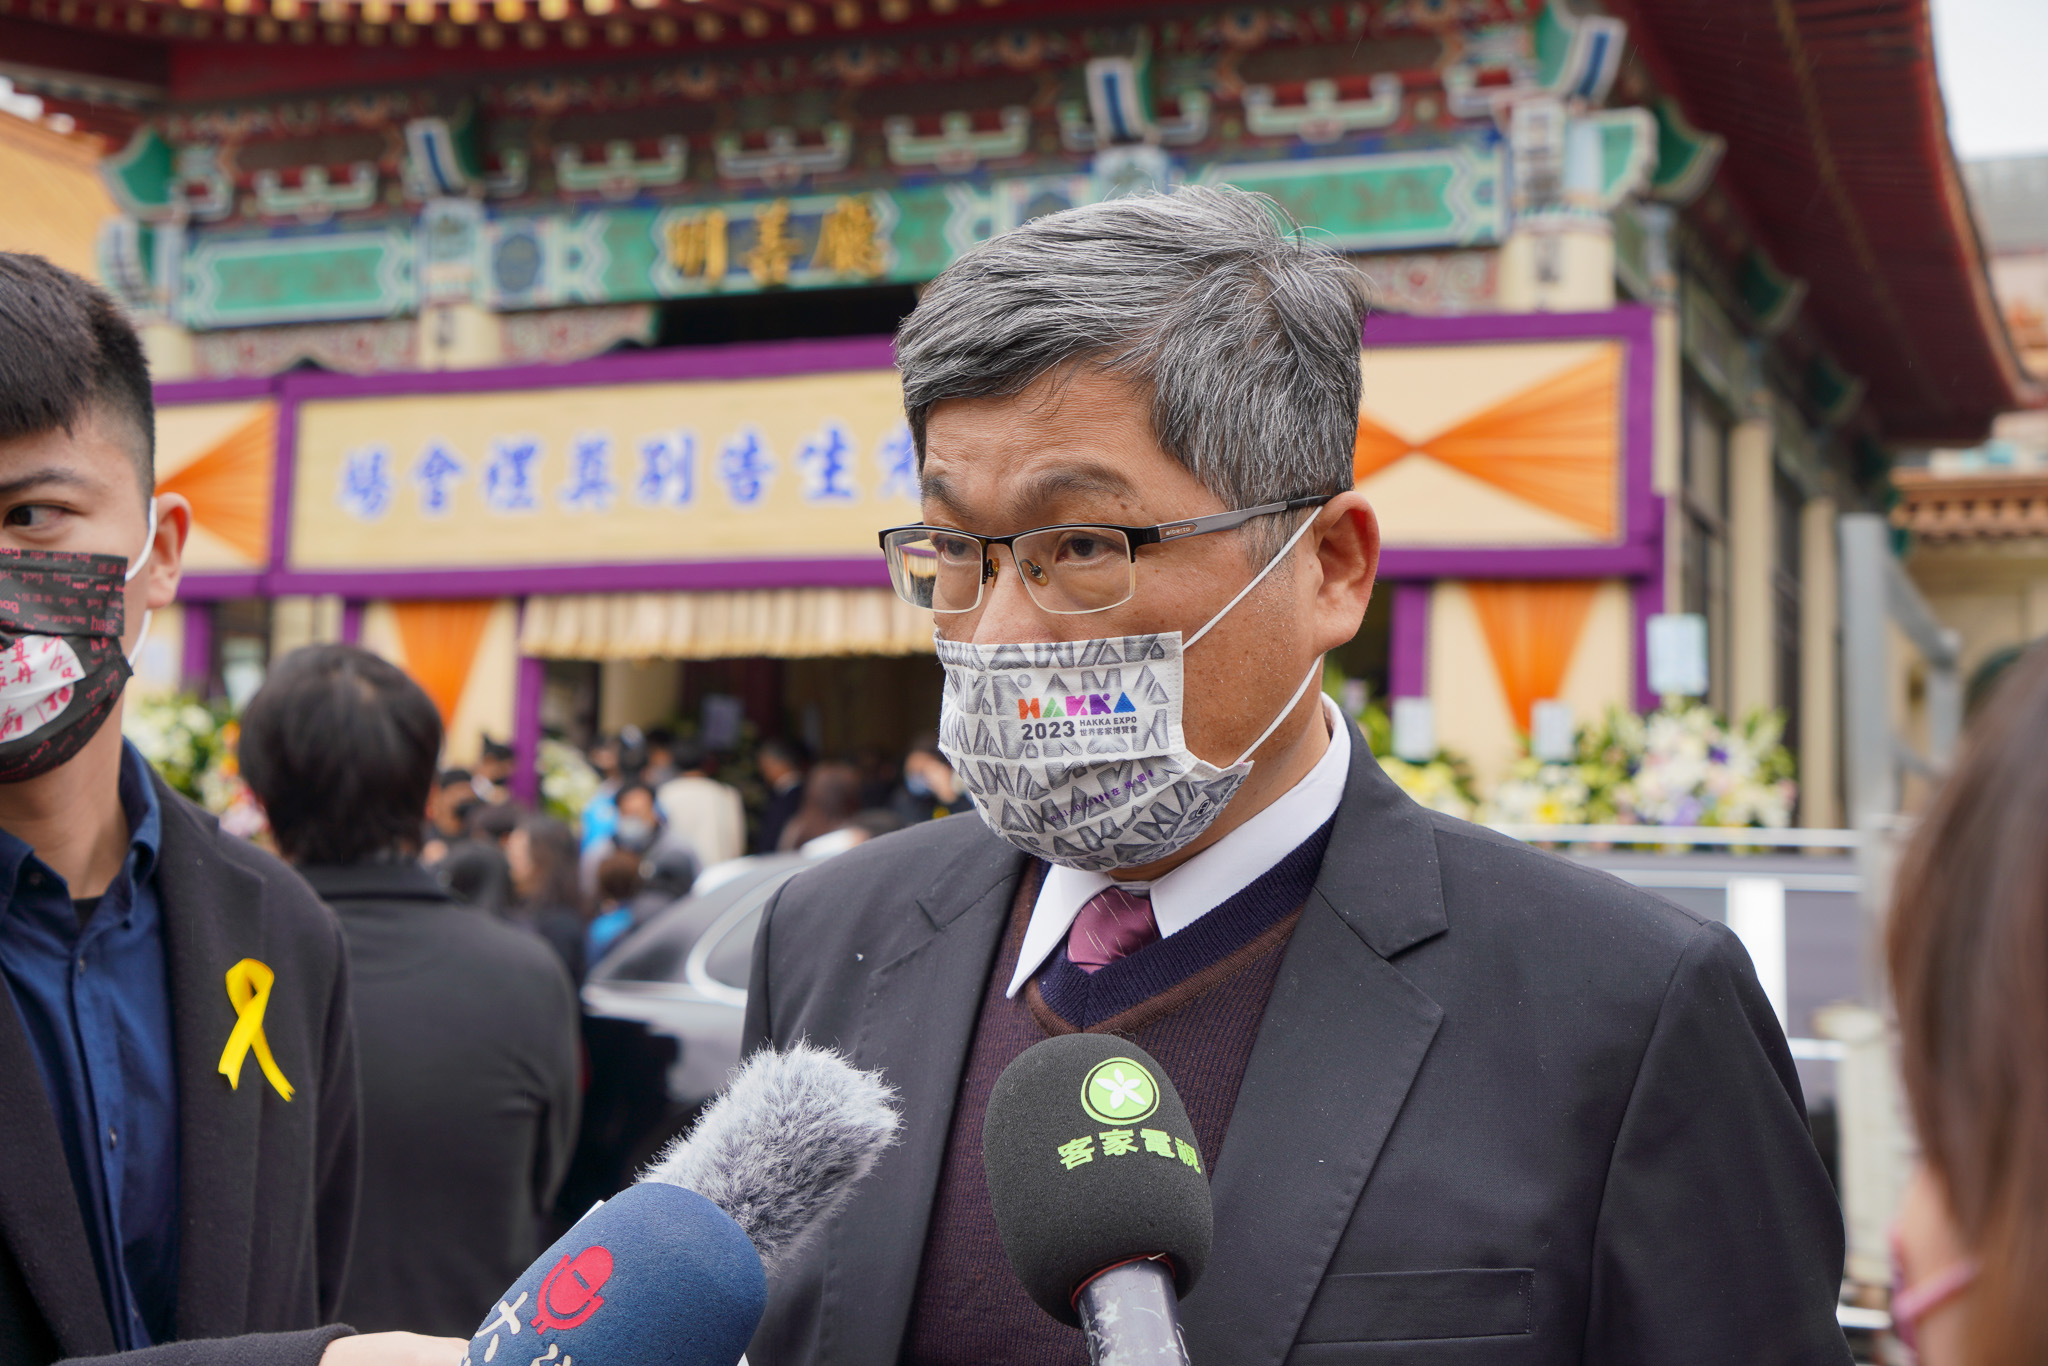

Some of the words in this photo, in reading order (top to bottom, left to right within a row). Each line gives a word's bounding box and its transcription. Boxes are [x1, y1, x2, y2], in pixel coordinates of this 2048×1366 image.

[1018, 691, 1136, 720] HAKKA
[1021, 720, 1075, 740] 2023
[1080, 718, 1111, 727] HAKKA
[1113, 716, 1137, 725] EXPO
[1080, 725, 1138, 737] 世界客家博覽會
[1058, 1128, 1201, 1174] 客家電視
